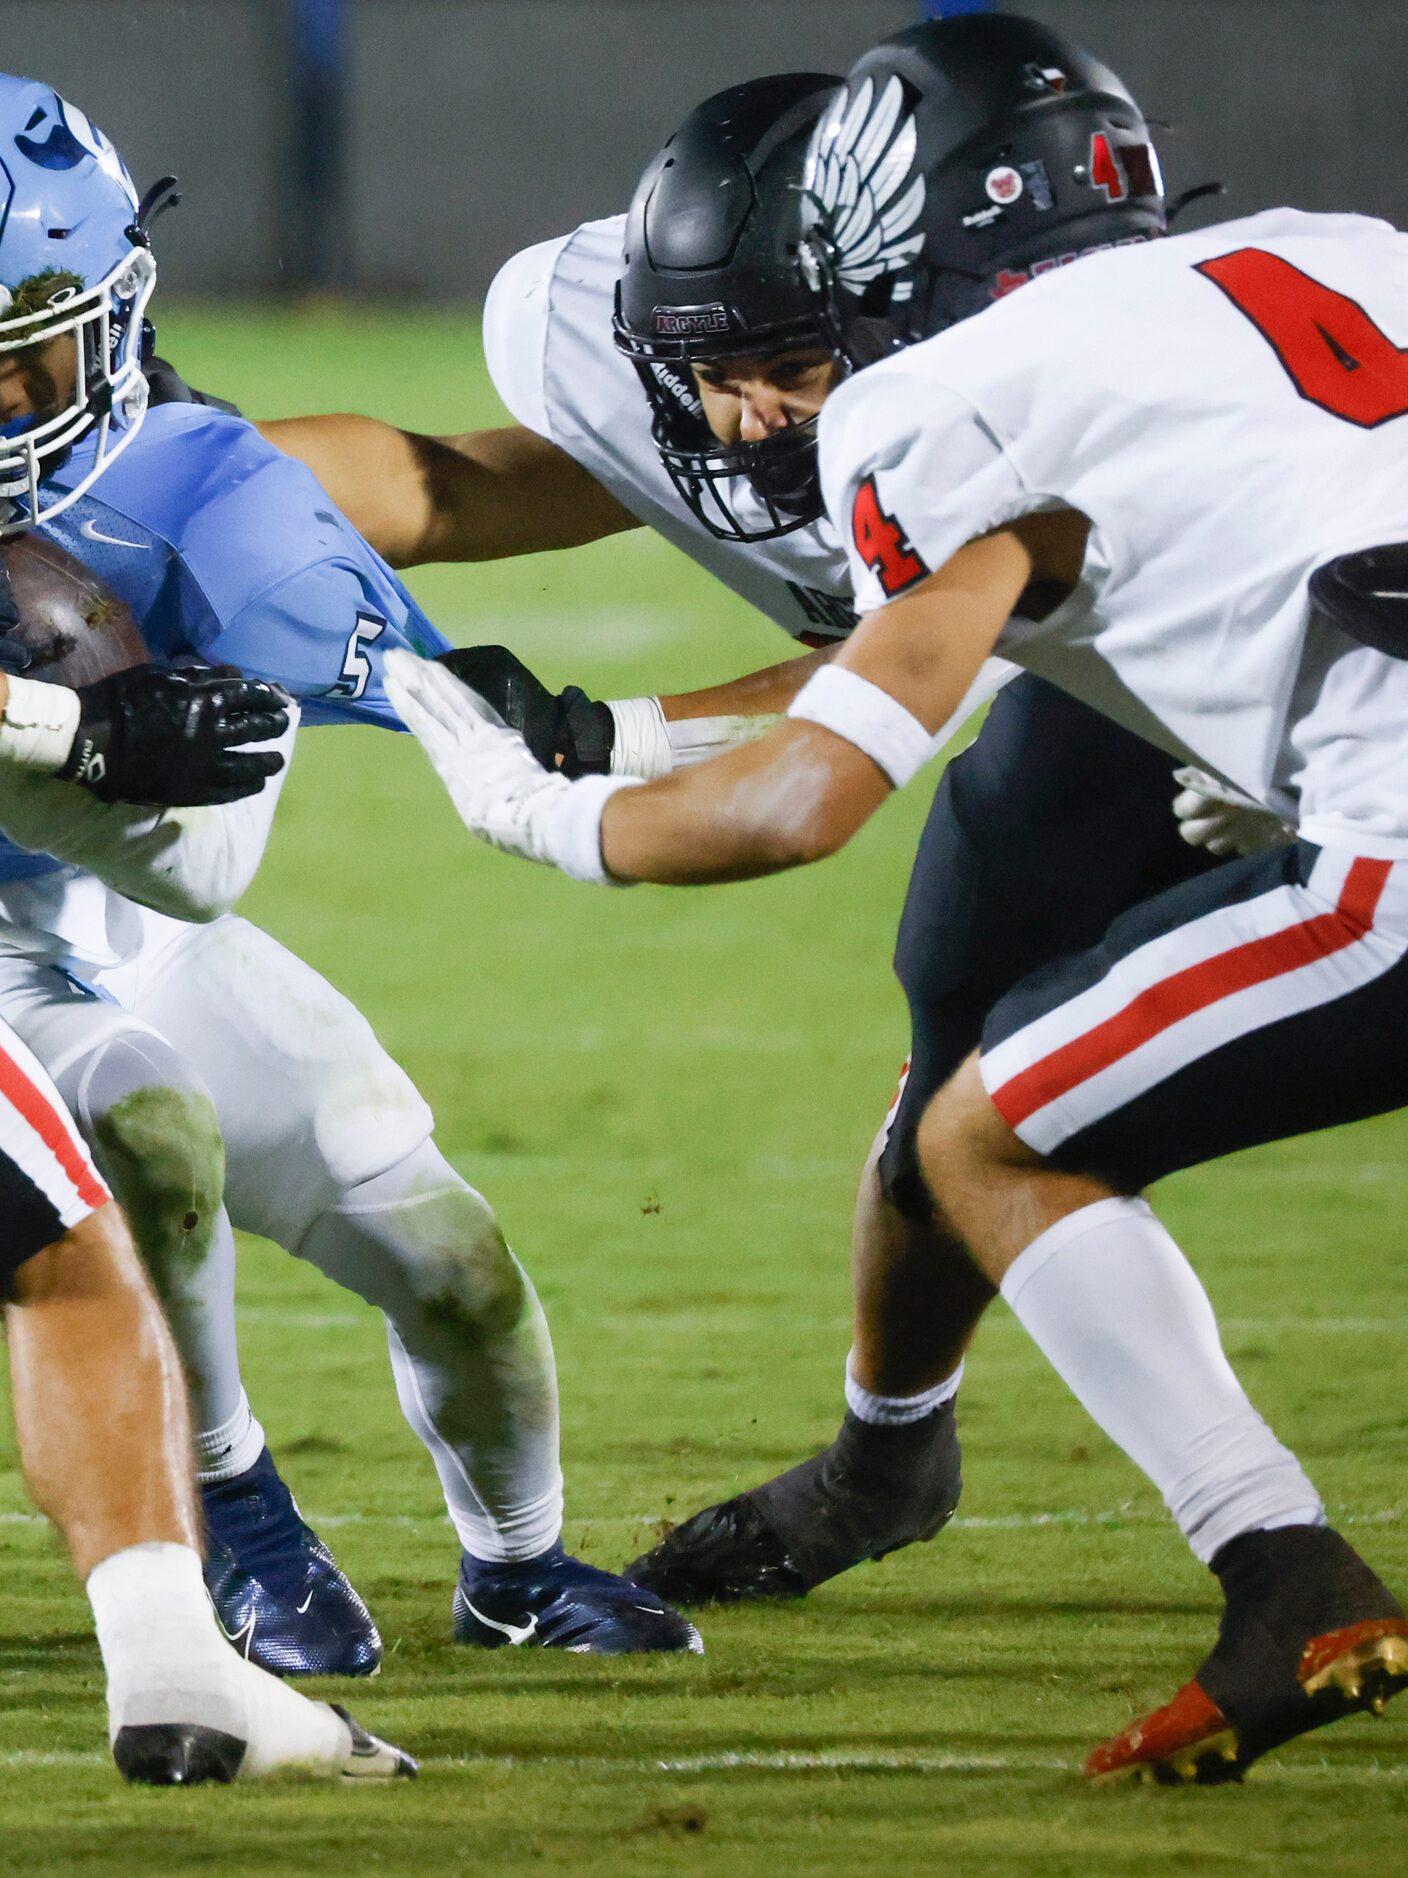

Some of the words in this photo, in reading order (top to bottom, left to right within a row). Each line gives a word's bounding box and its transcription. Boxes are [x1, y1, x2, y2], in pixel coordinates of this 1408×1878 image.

[1091, 131, 1129, 203] 4
[656, 313, 730, 334] ARGYLE
[1190, 246, 1408, 430] 4
[852, 472, 932, 600] 4
[324, 610, 387, 701] 5
